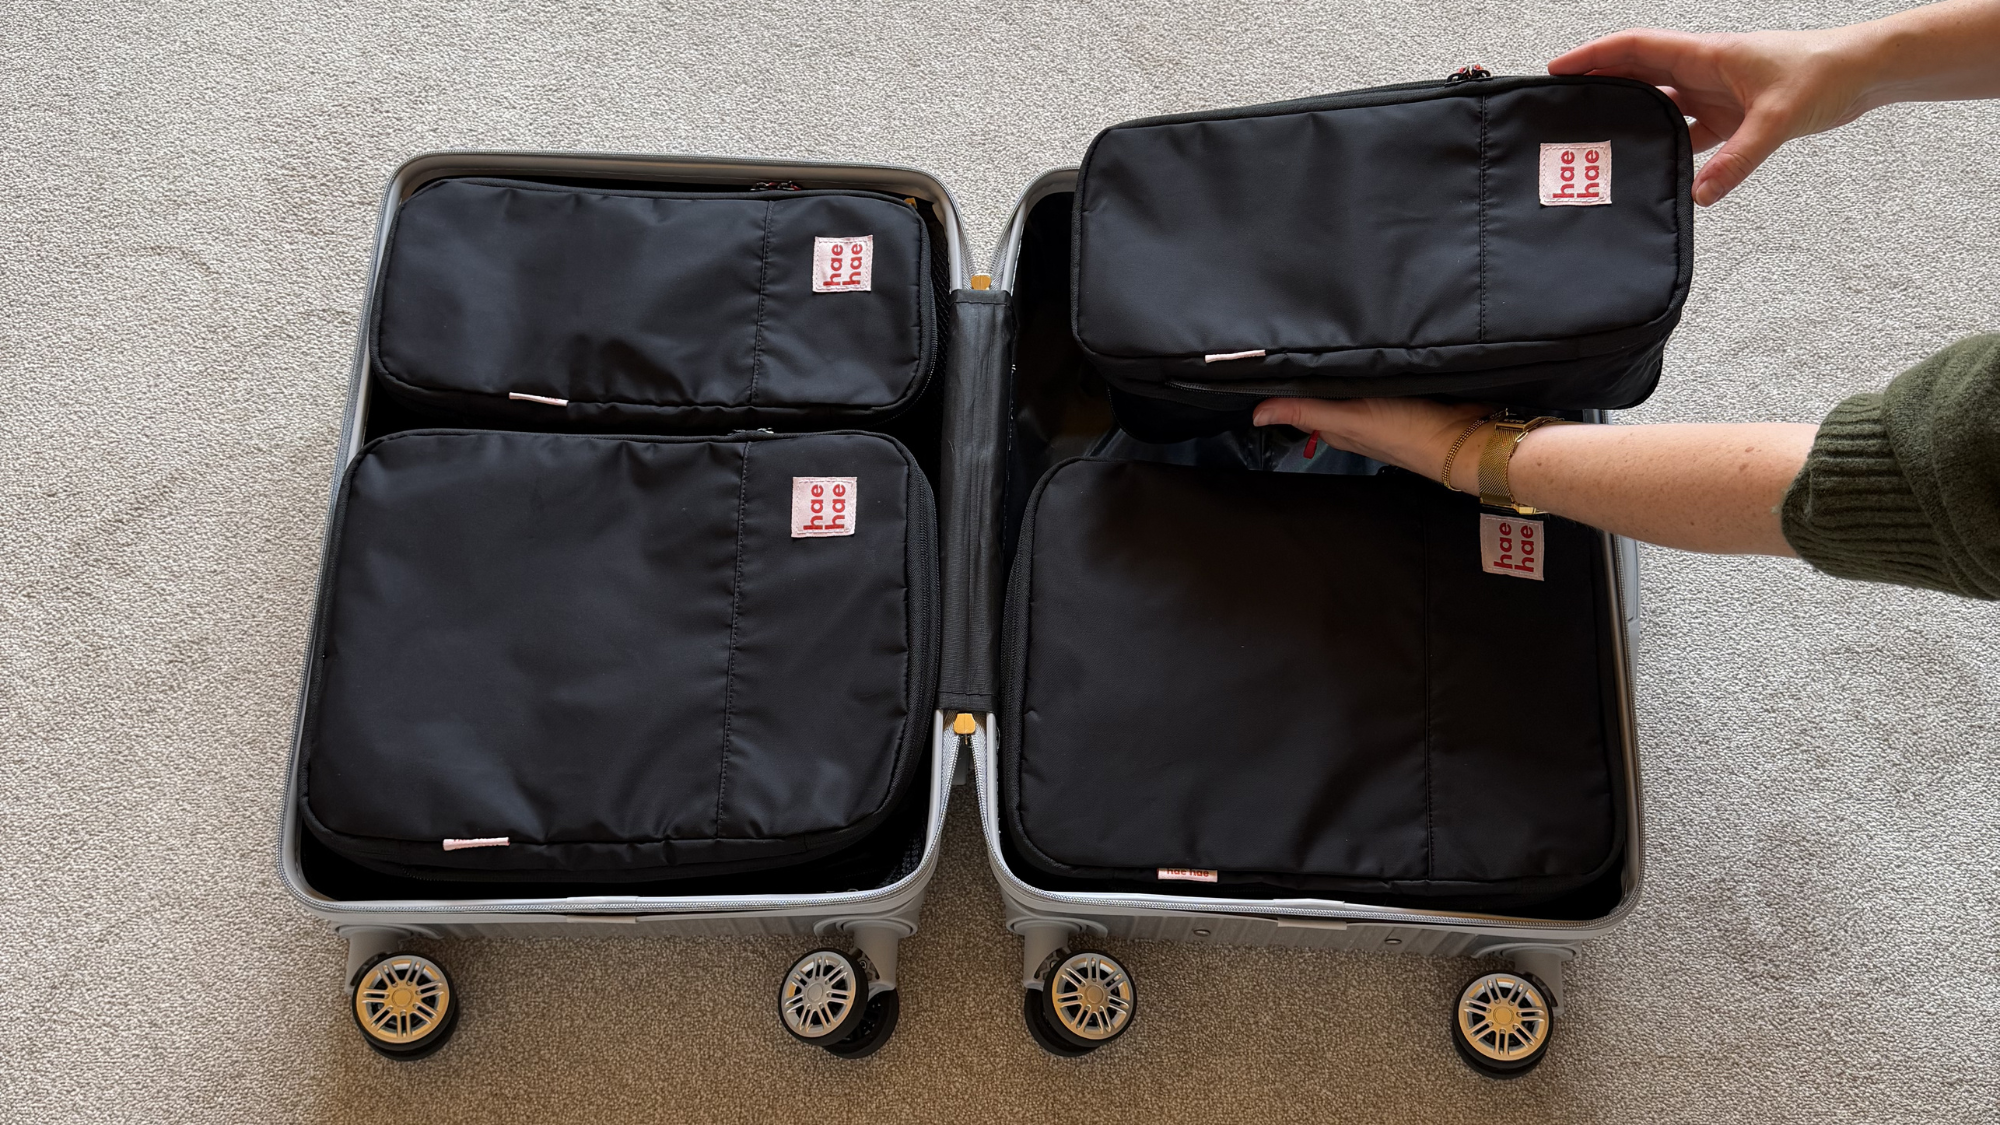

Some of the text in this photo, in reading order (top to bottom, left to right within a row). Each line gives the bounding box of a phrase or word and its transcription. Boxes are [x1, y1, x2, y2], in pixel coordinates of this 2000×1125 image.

[1552, 150, 1575, 198] hae
[1576, 149, 1600, 198] hae
[823, 243, 843, 286] hae
[842, 243, 863, 286] hae
[803, 484, 824, 530] hae
[824, 483, 846, 530] hae
[1493, 522, 1513, 569] hae
[1514, 525, 1535, 573] hae
